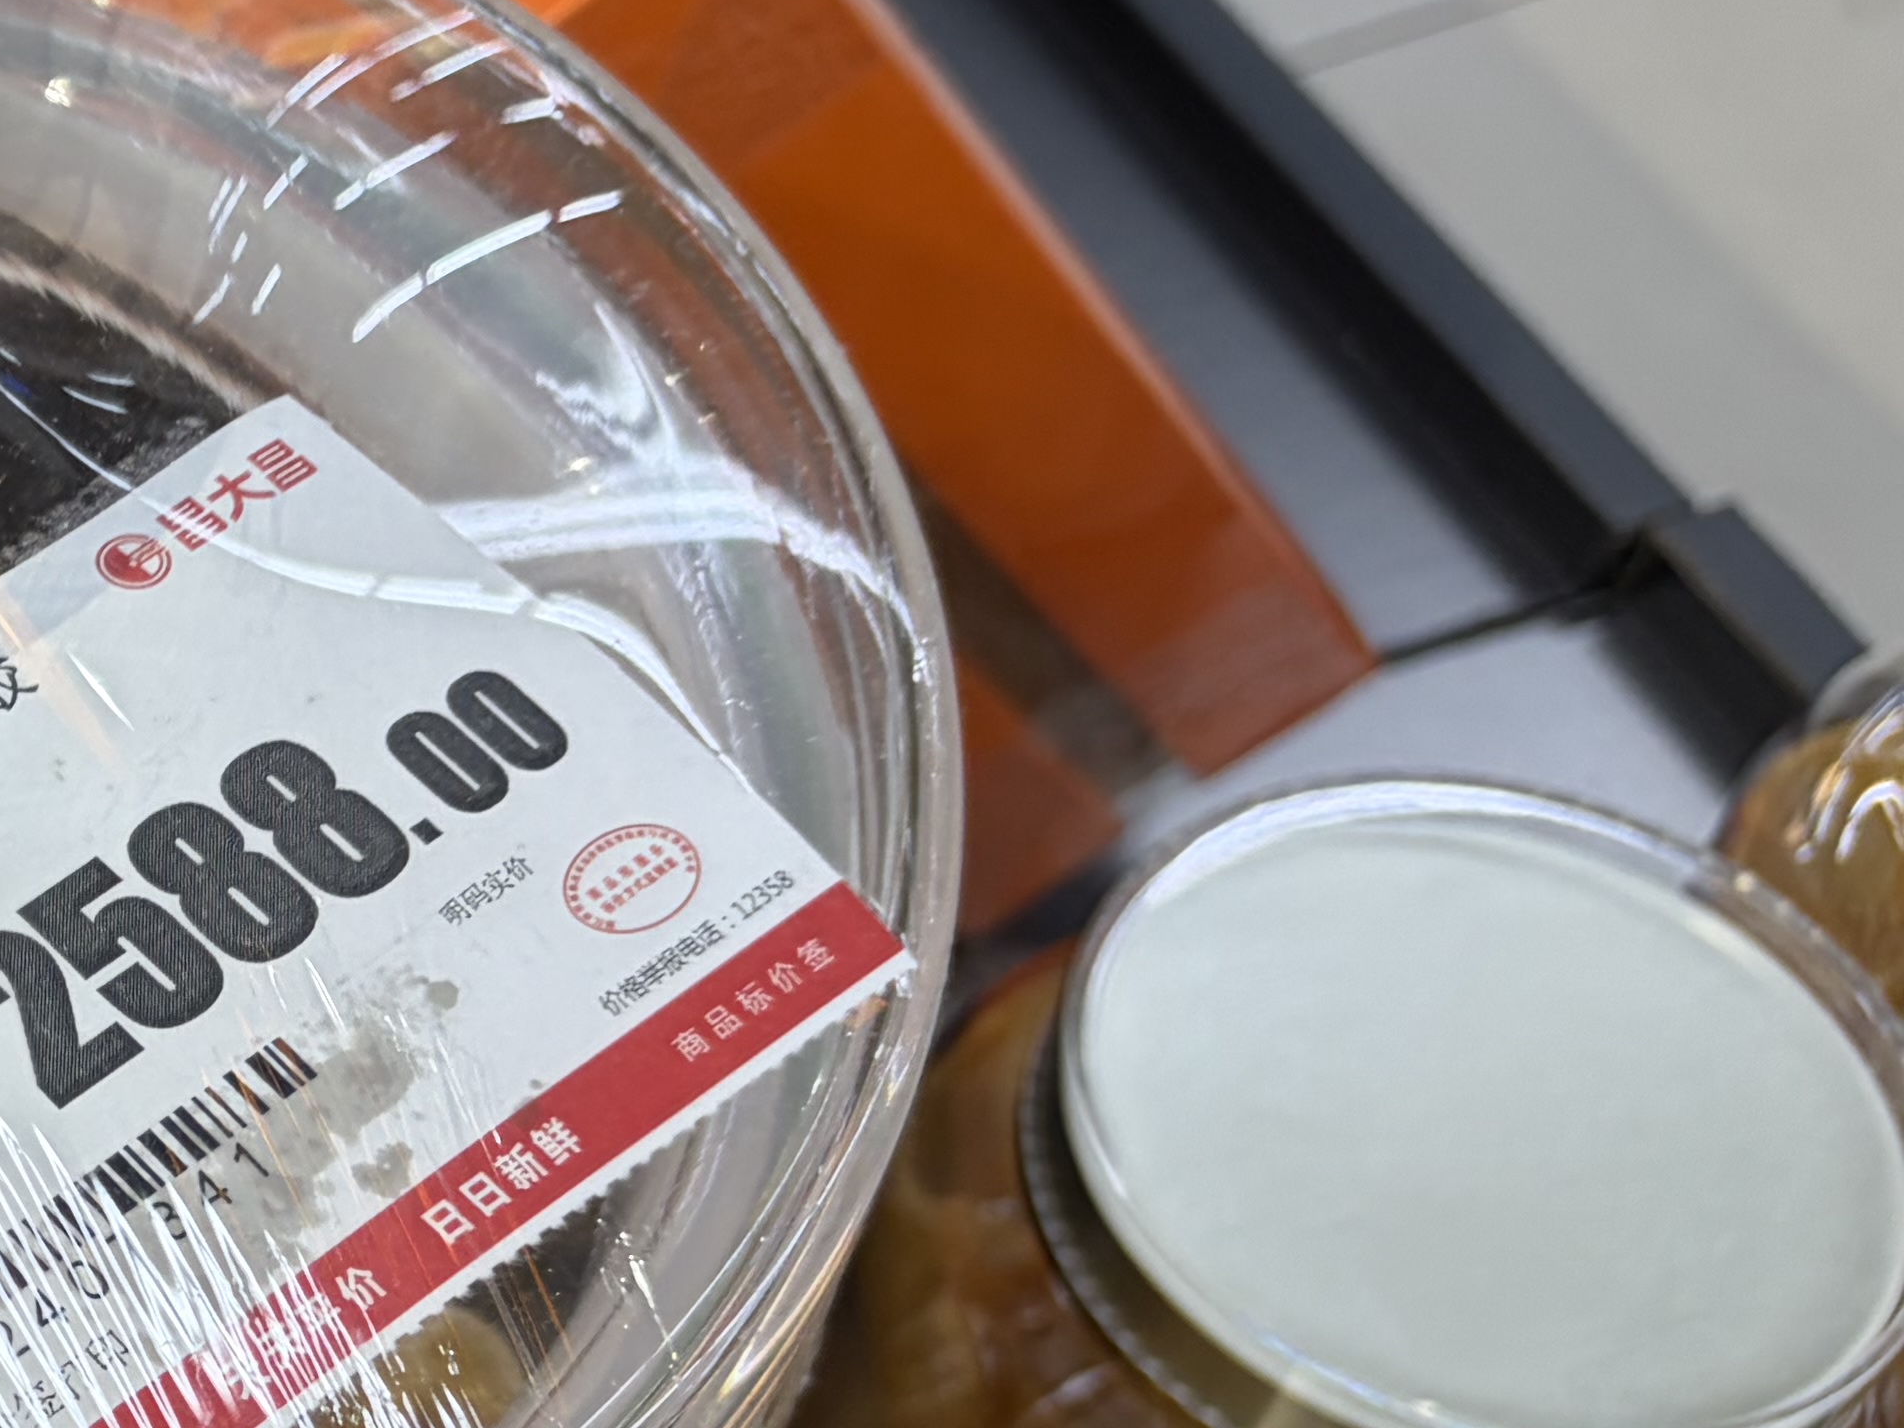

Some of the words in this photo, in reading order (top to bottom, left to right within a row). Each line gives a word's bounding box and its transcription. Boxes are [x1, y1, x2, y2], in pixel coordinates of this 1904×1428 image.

[155, 438, 318, 551] 昌大昌
[437, 854, 534, 926] 明码实价
[671, 936, 836, 1063] 商品标价签
[421, 1116, 583, 1244] 日日新鲜
